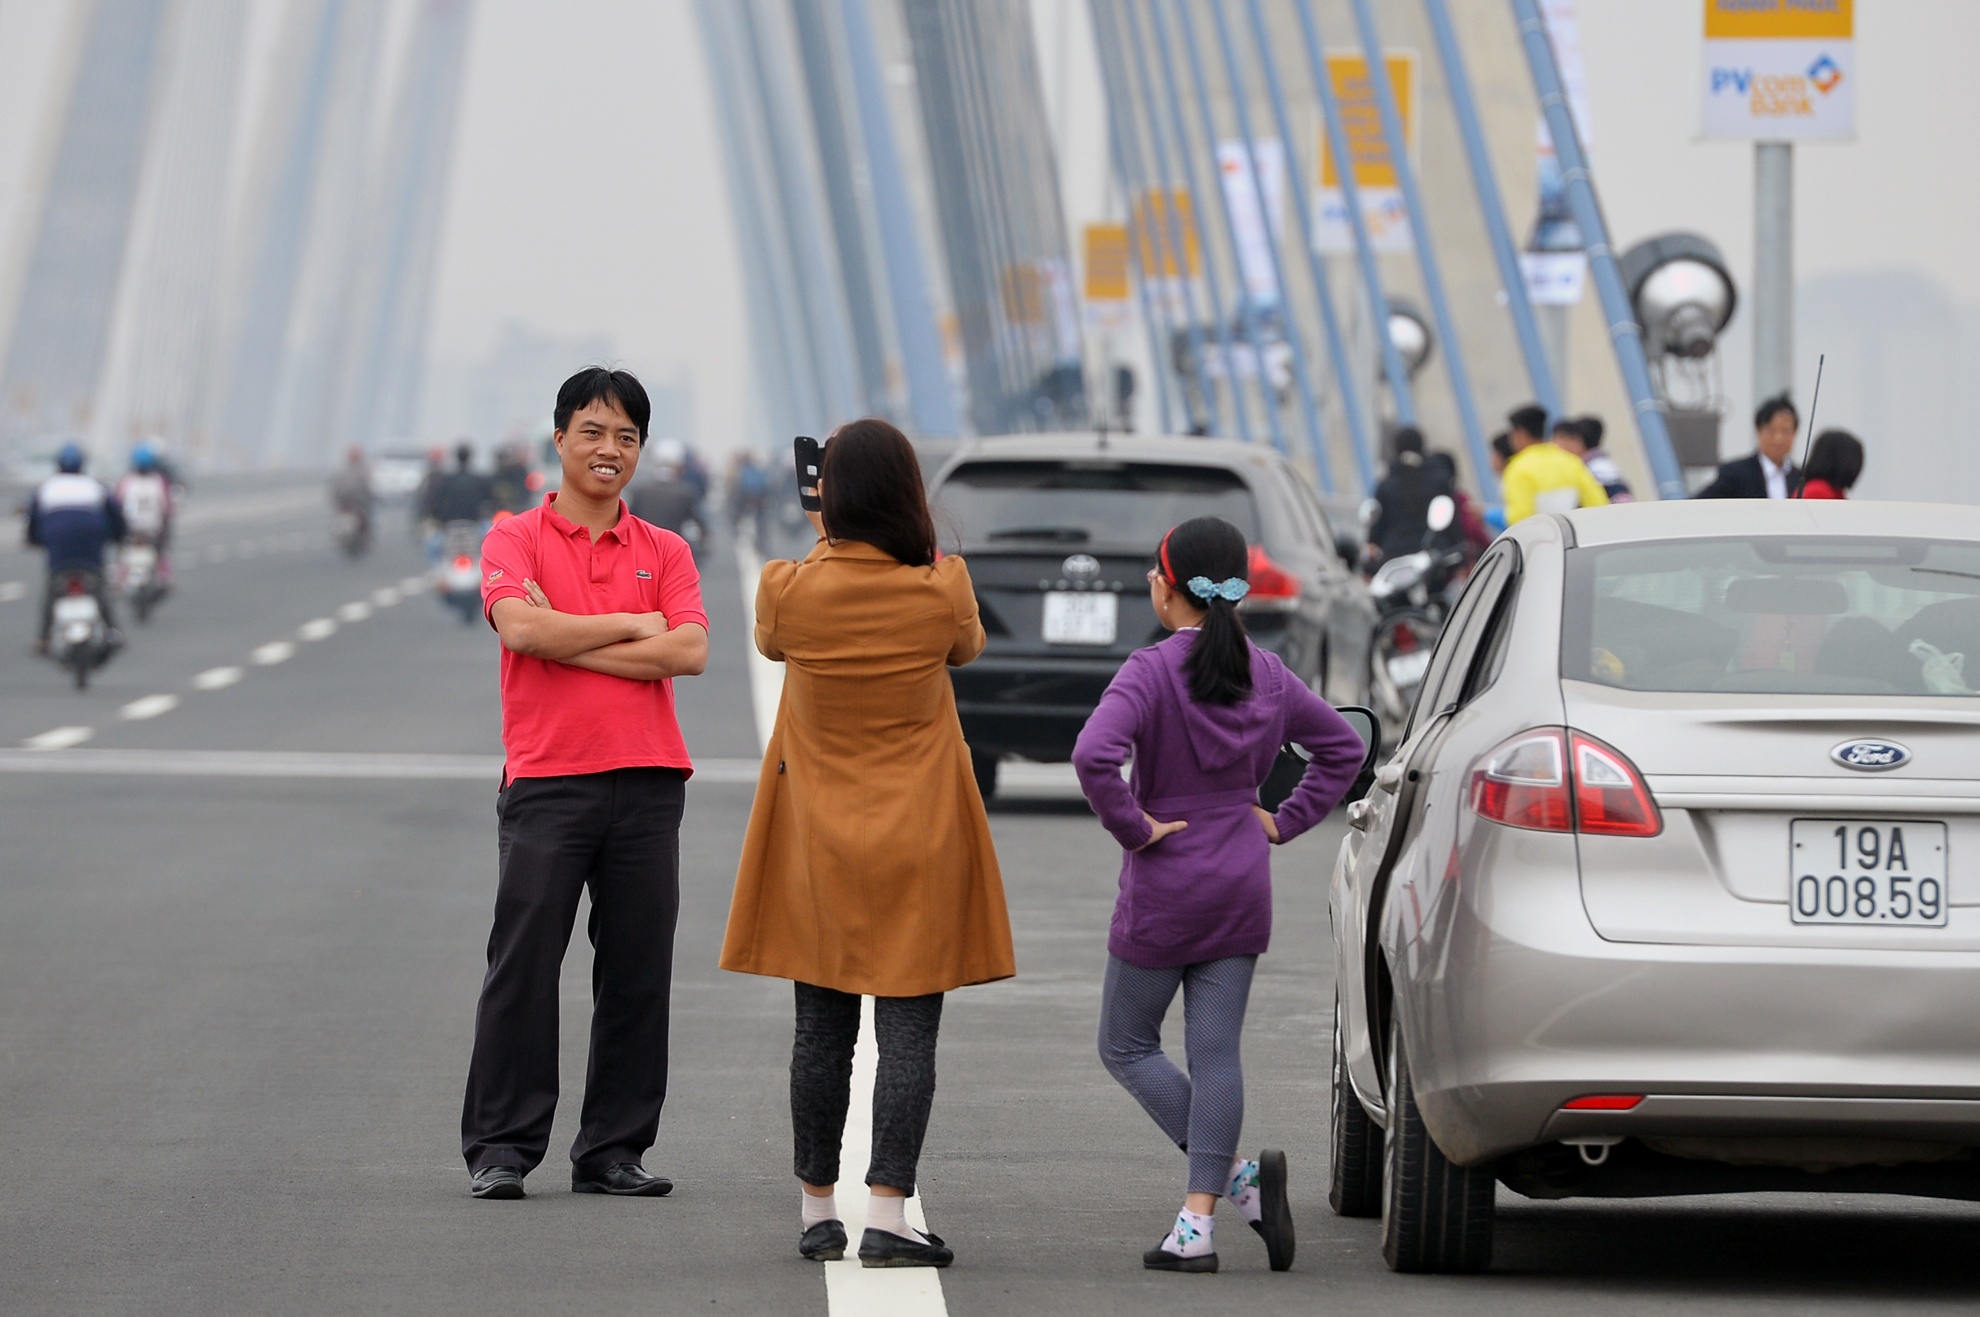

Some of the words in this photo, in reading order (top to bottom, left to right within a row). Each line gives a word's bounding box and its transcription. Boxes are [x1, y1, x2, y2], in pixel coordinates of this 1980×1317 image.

[1848, 743, 1895, 764] Ford
[1834, 825, 1908, 871] 19A
[1797, 874, 1941, 920] 008.59
